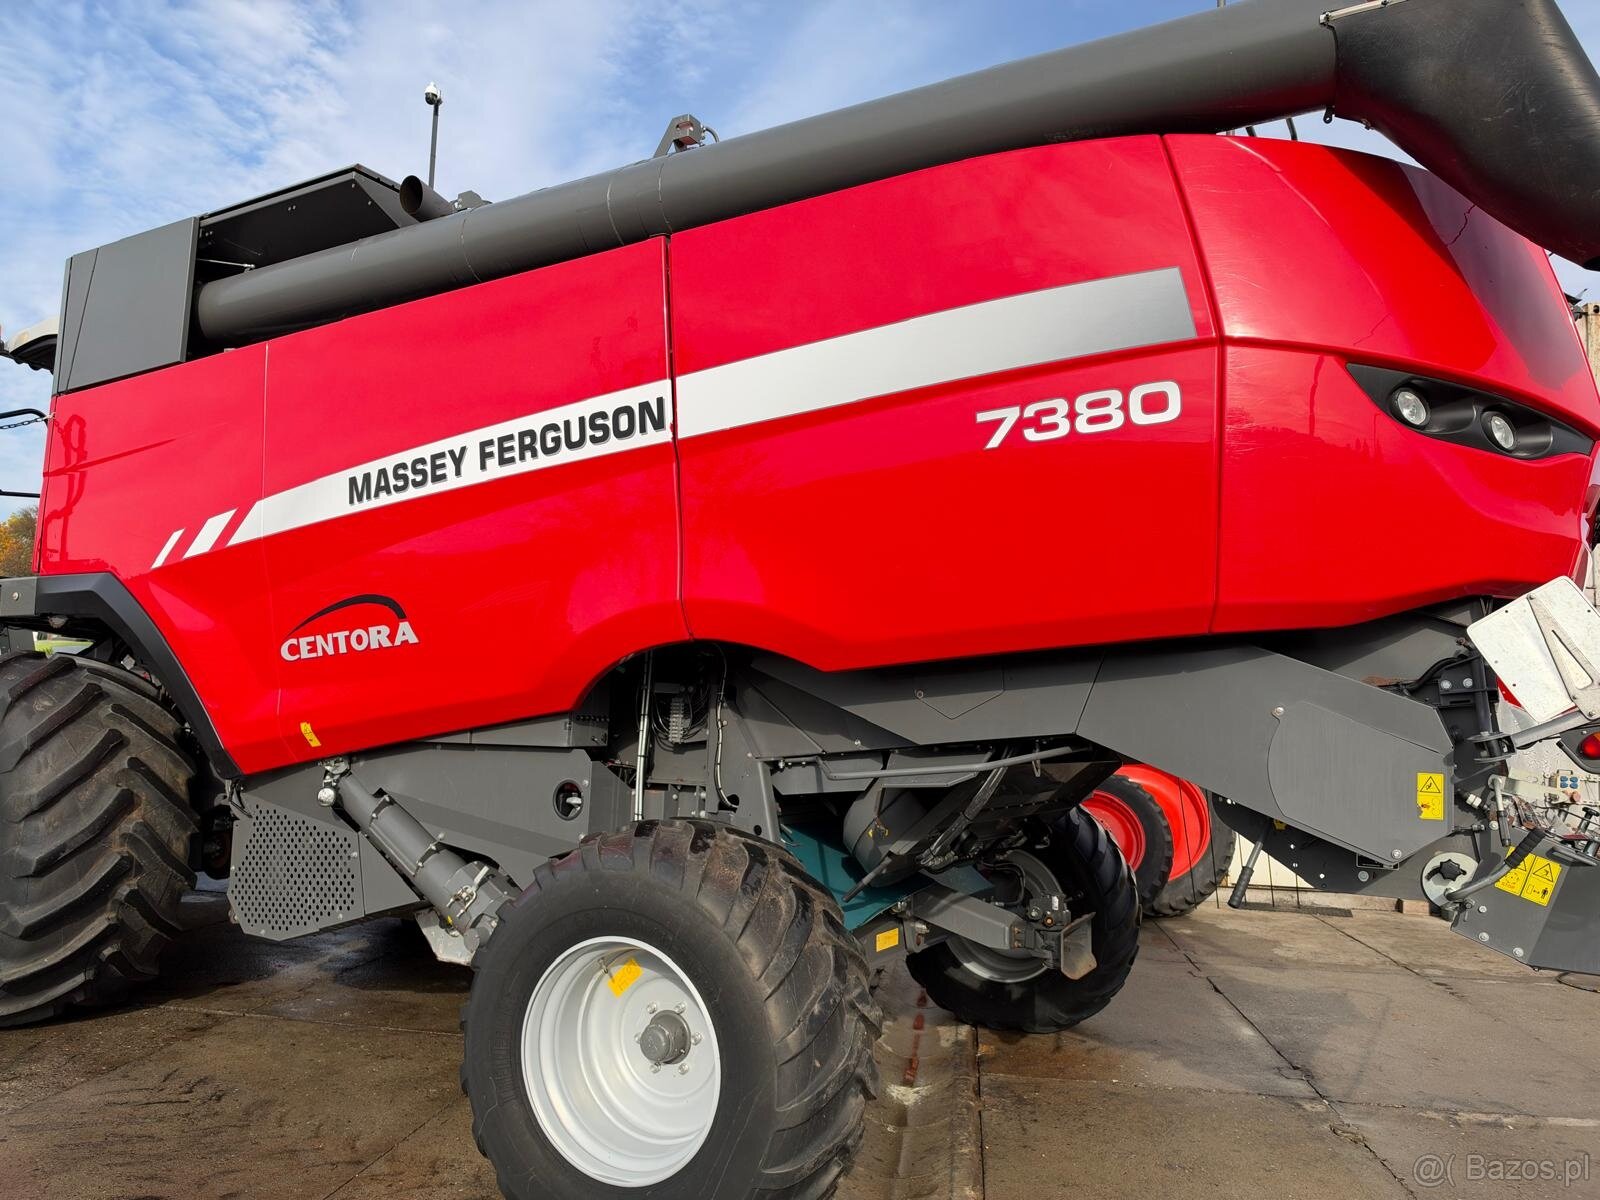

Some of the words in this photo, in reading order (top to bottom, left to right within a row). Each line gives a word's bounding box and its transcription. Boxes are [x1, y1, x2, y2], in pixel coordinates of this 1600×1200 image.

[976, 380, 1182, 450] 7380
[348, 445, 468, 506] MASSEY
[478, 396, 666, 472] FERGUSON
[280, 620, 420, 662] CENTORA
